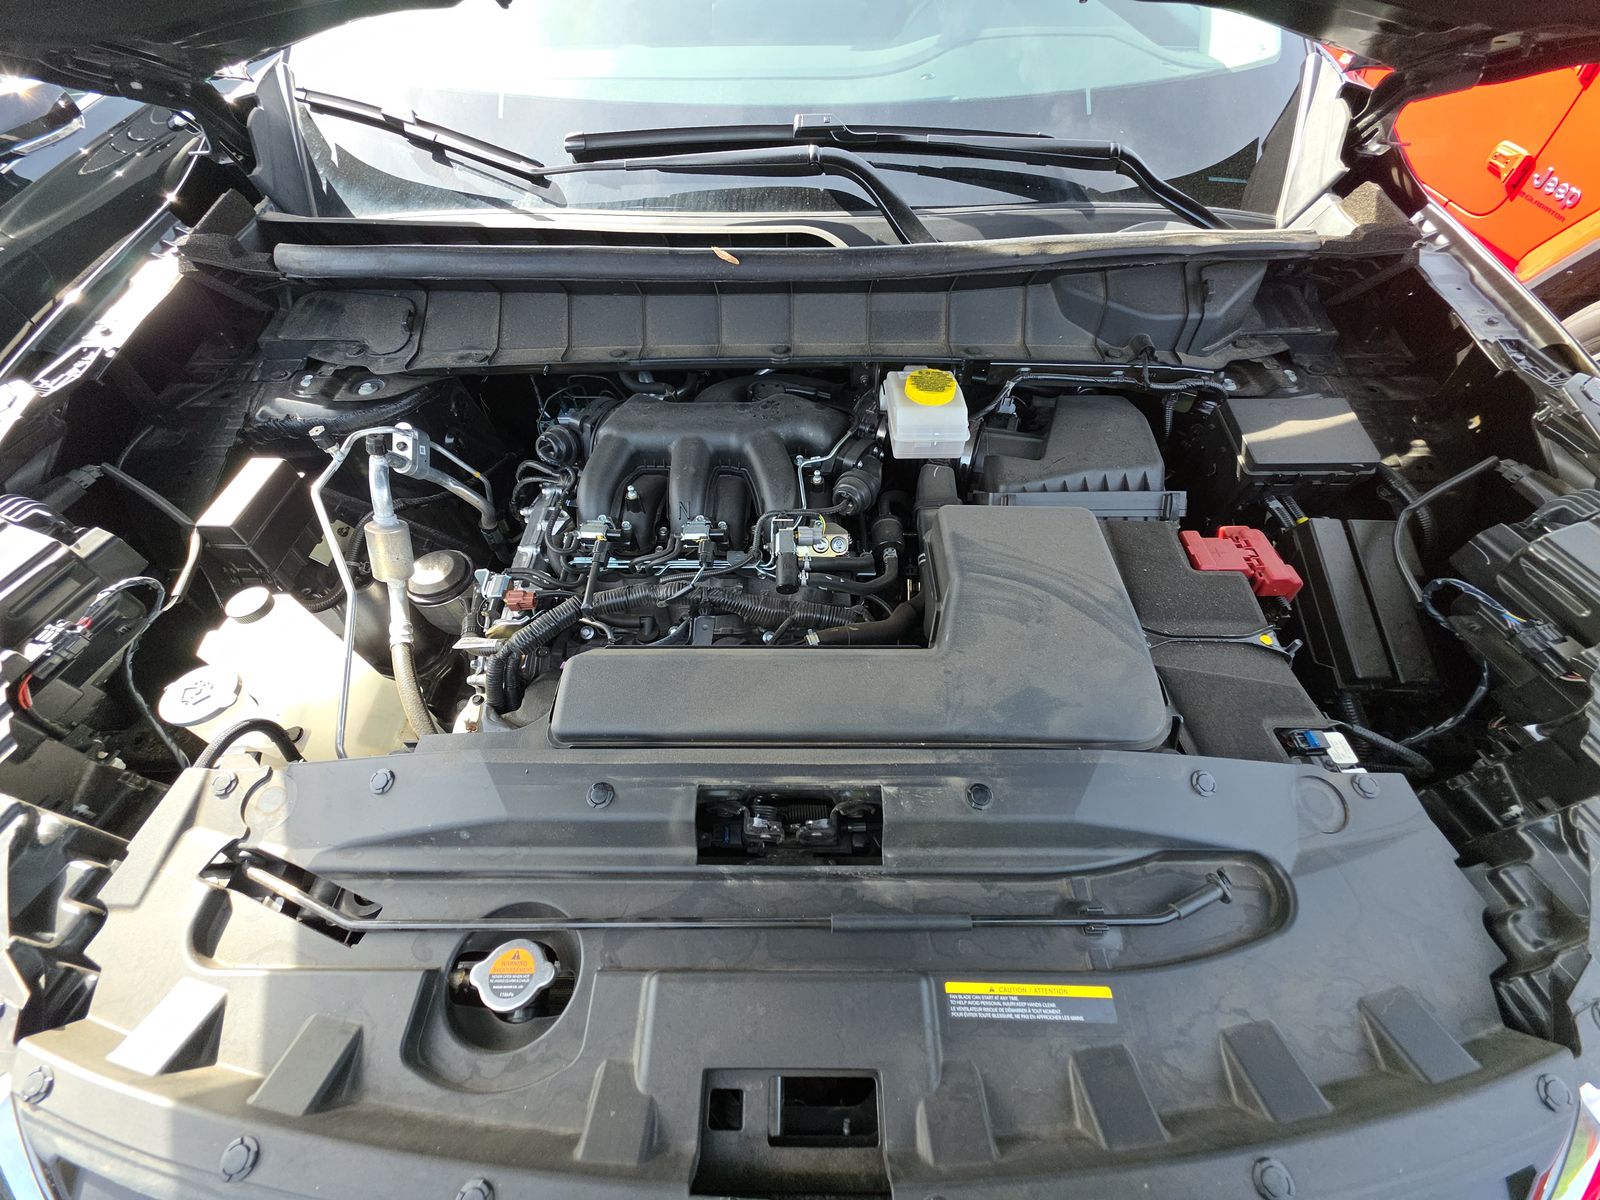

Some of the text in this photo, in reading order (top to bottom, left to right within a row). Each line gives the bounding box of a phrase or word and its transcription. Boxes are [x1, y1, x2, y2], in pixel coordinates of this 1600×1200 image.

[1533, 166, 1582, 210] Jeep
[1525, 194, 1565, 222] GLADIATOR
[1034, 987, 1069, 995] ATTENTION
